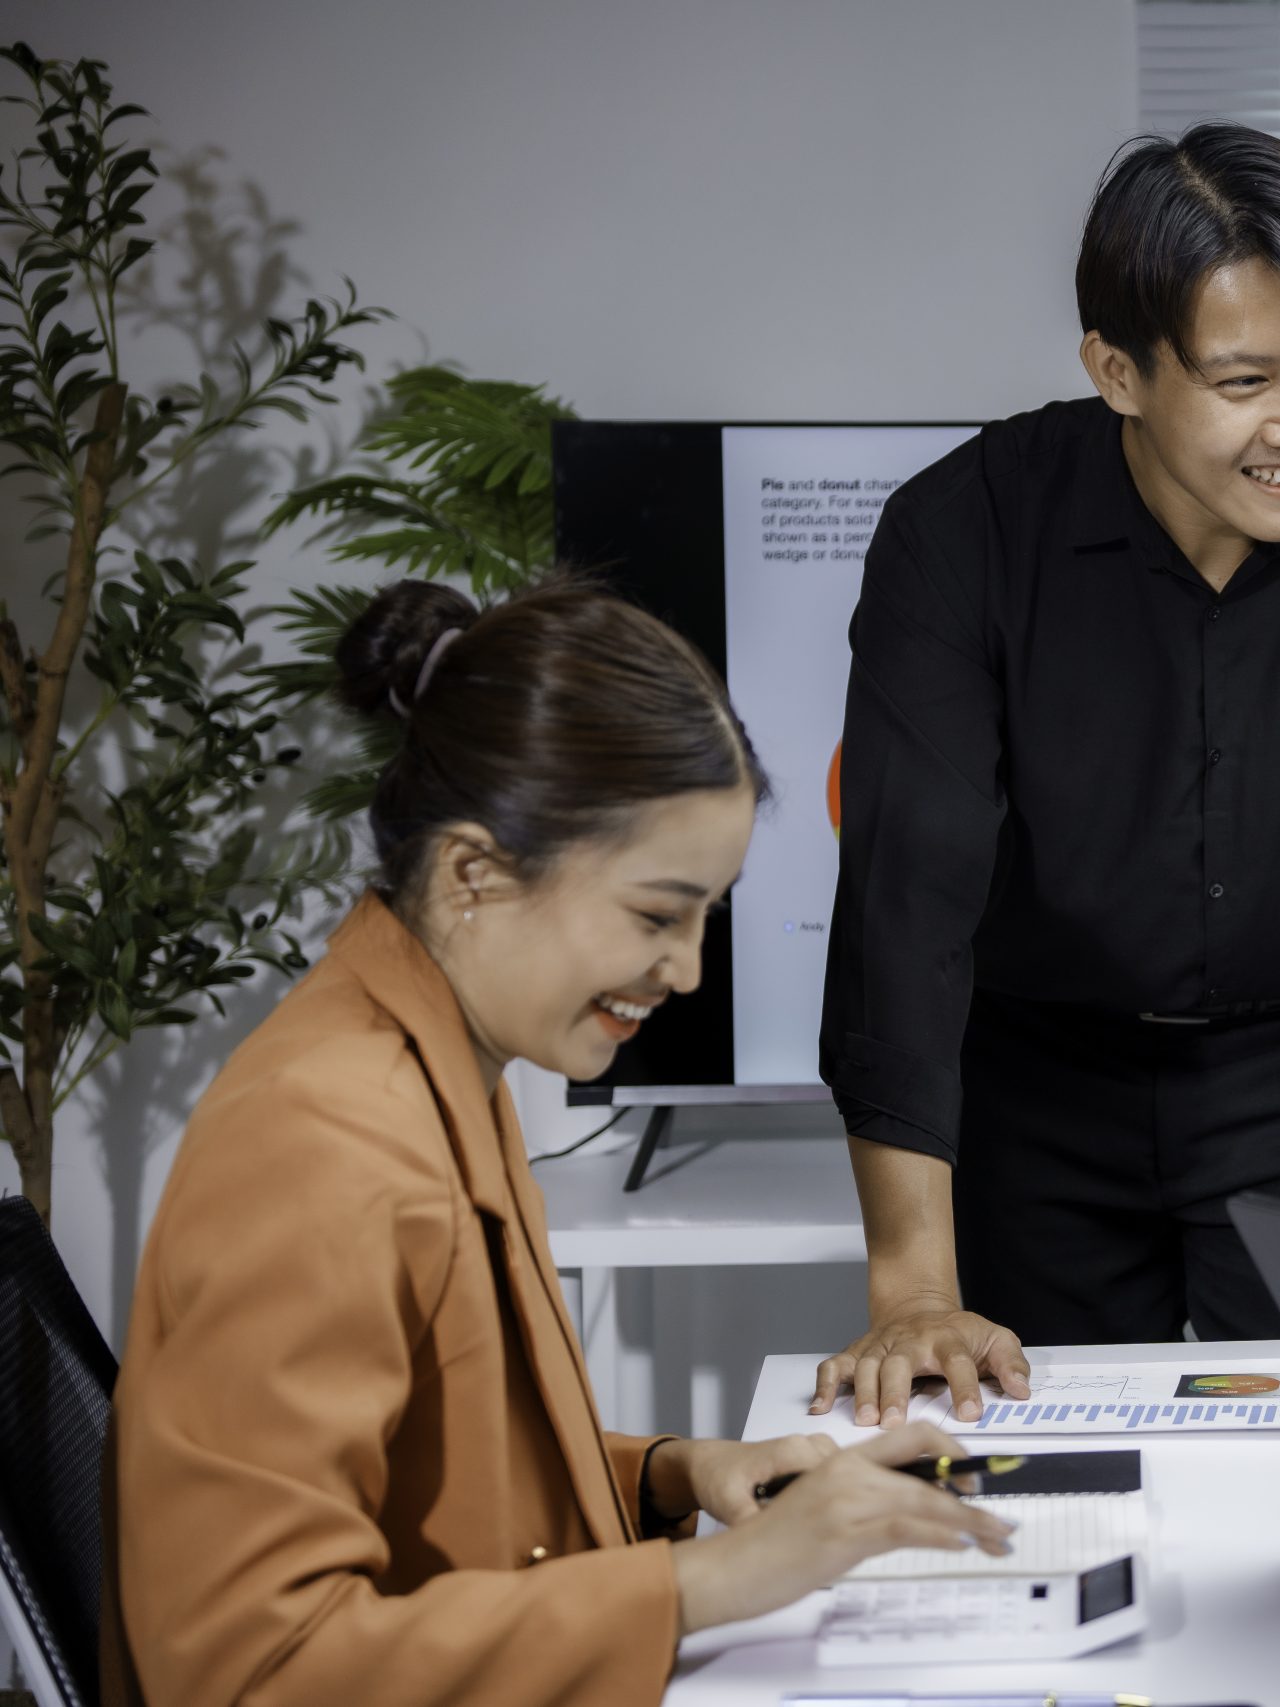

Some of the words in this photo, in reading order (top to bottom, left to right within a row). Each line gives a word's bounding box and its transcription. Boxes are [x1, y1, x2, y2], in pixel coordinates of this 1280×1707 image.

[761, 478, 784, 491] Pie
[788, 479, 815, 491] and
[818, 479, 861, 491] donut
[828, 495, 852, 509] For
[761, 513, 777, 527] of
[779, 512, 841, 528] products
[844, 512, 874, 526] sold
[762, 530, 808, 544] shown
[811, 533, 828, 544] as
[831, 533, 841, 543] a
[763, 549, 809, 563] wedge
[812, 550, 827, 561] or
